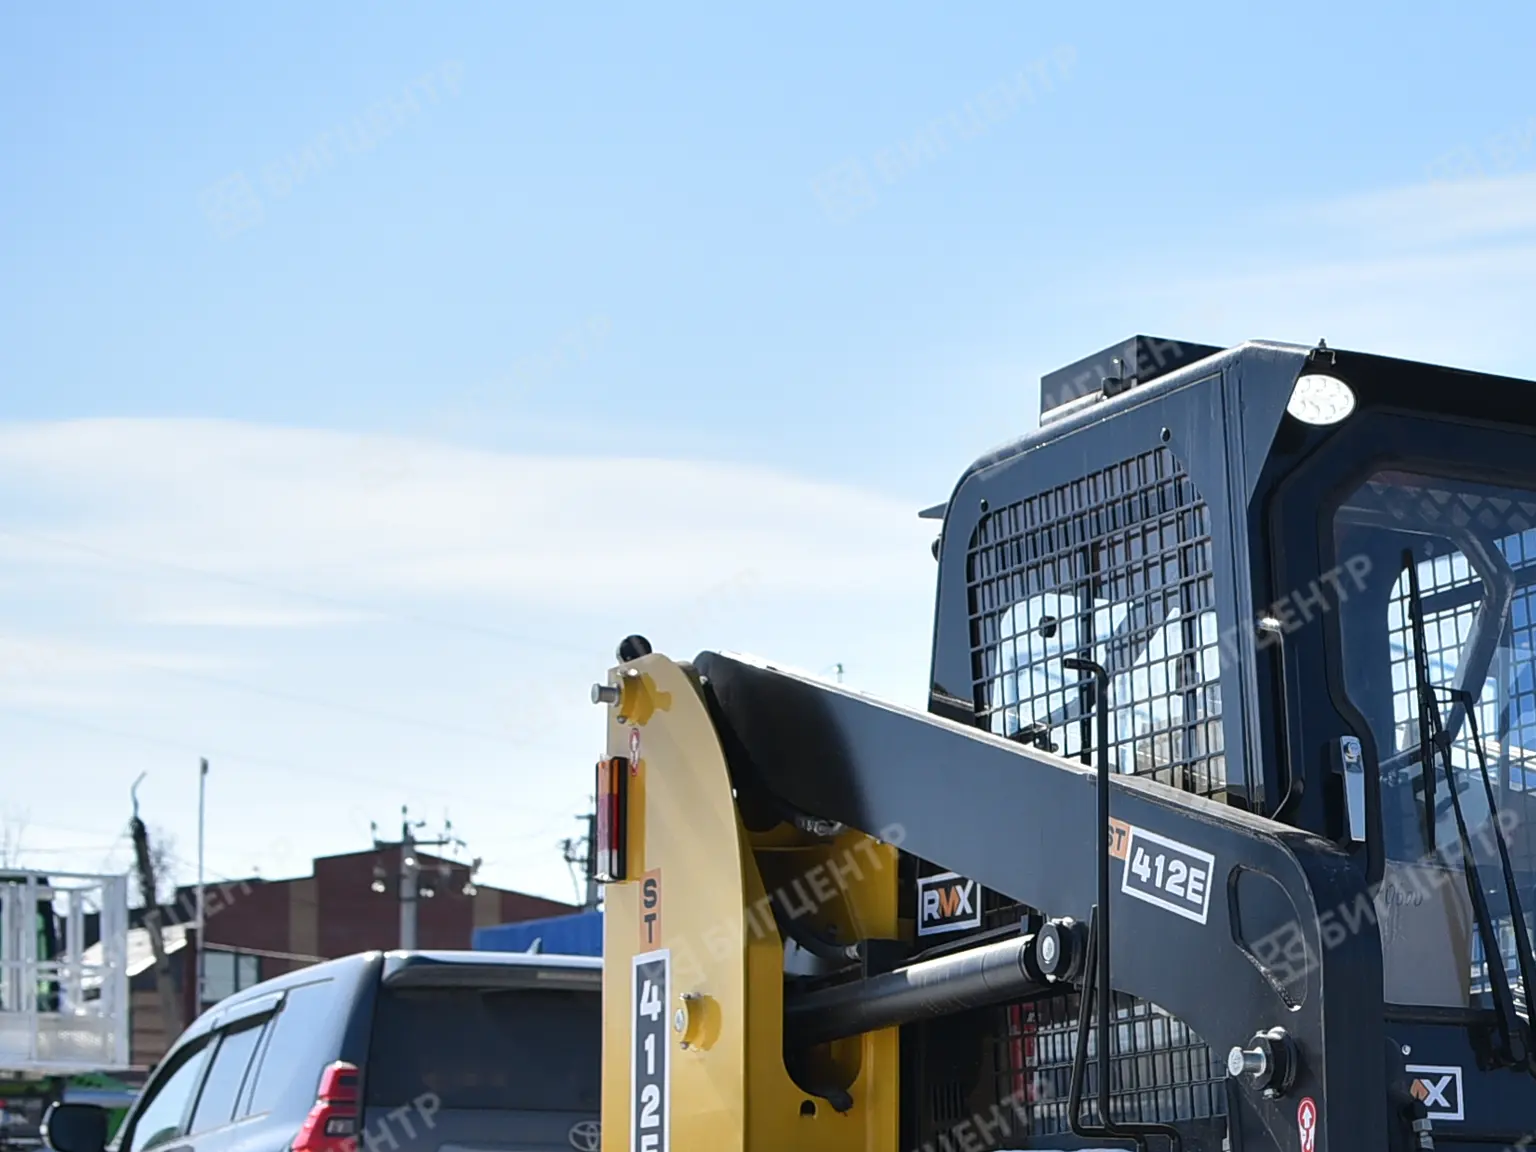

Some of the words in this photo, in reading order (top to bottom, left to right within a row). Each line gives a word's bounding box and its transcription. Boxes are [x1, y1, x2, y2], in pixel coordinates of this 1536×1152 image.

[923, 879, 974, 921] RMX
[1131, 846, 1206, 905] 412E
[643, 878, 658, 944] ST
